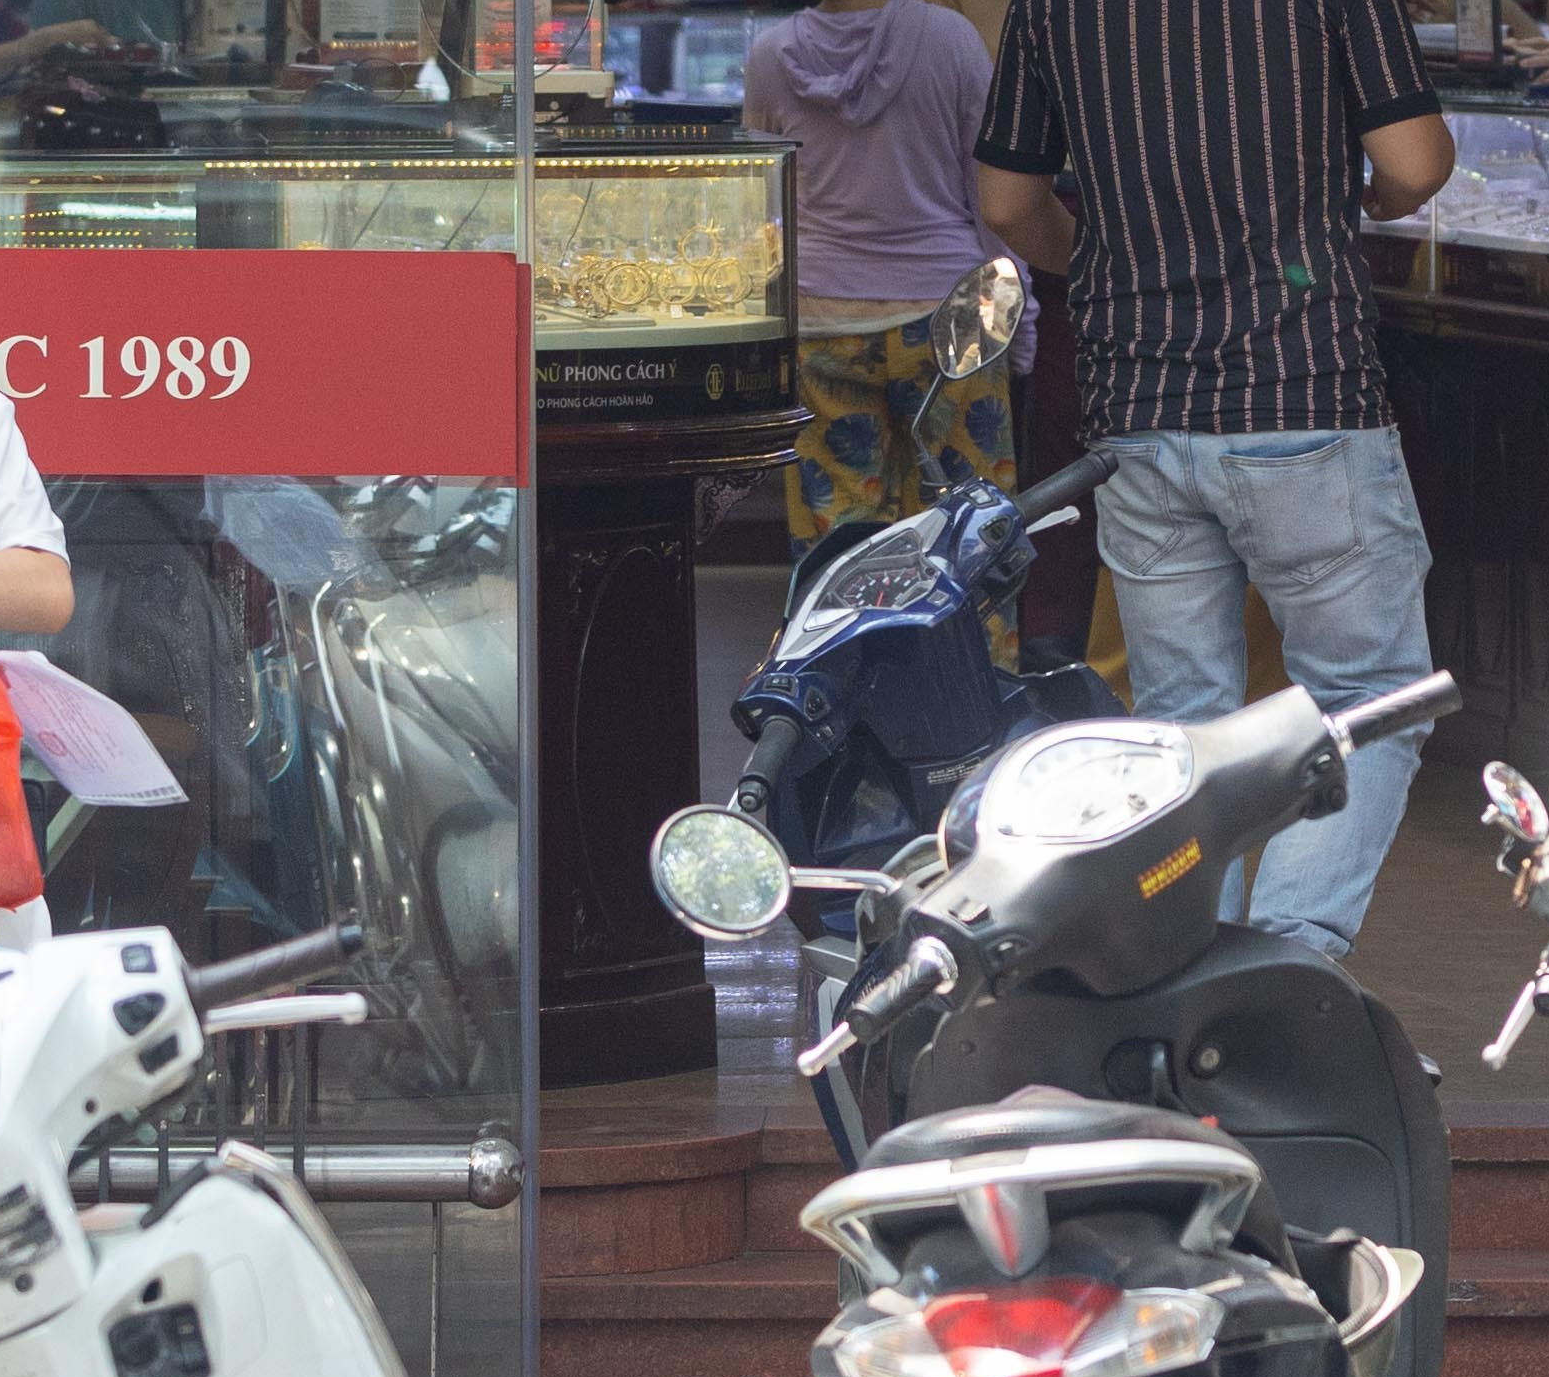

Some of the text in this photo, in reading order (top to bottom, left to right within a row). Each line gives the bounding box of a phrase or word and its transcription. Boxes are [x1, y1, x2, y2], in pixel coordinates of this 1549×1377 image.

[79, 335, 251, 401] 1989
[565, 360, 665, 382] PHONG CÁCH
